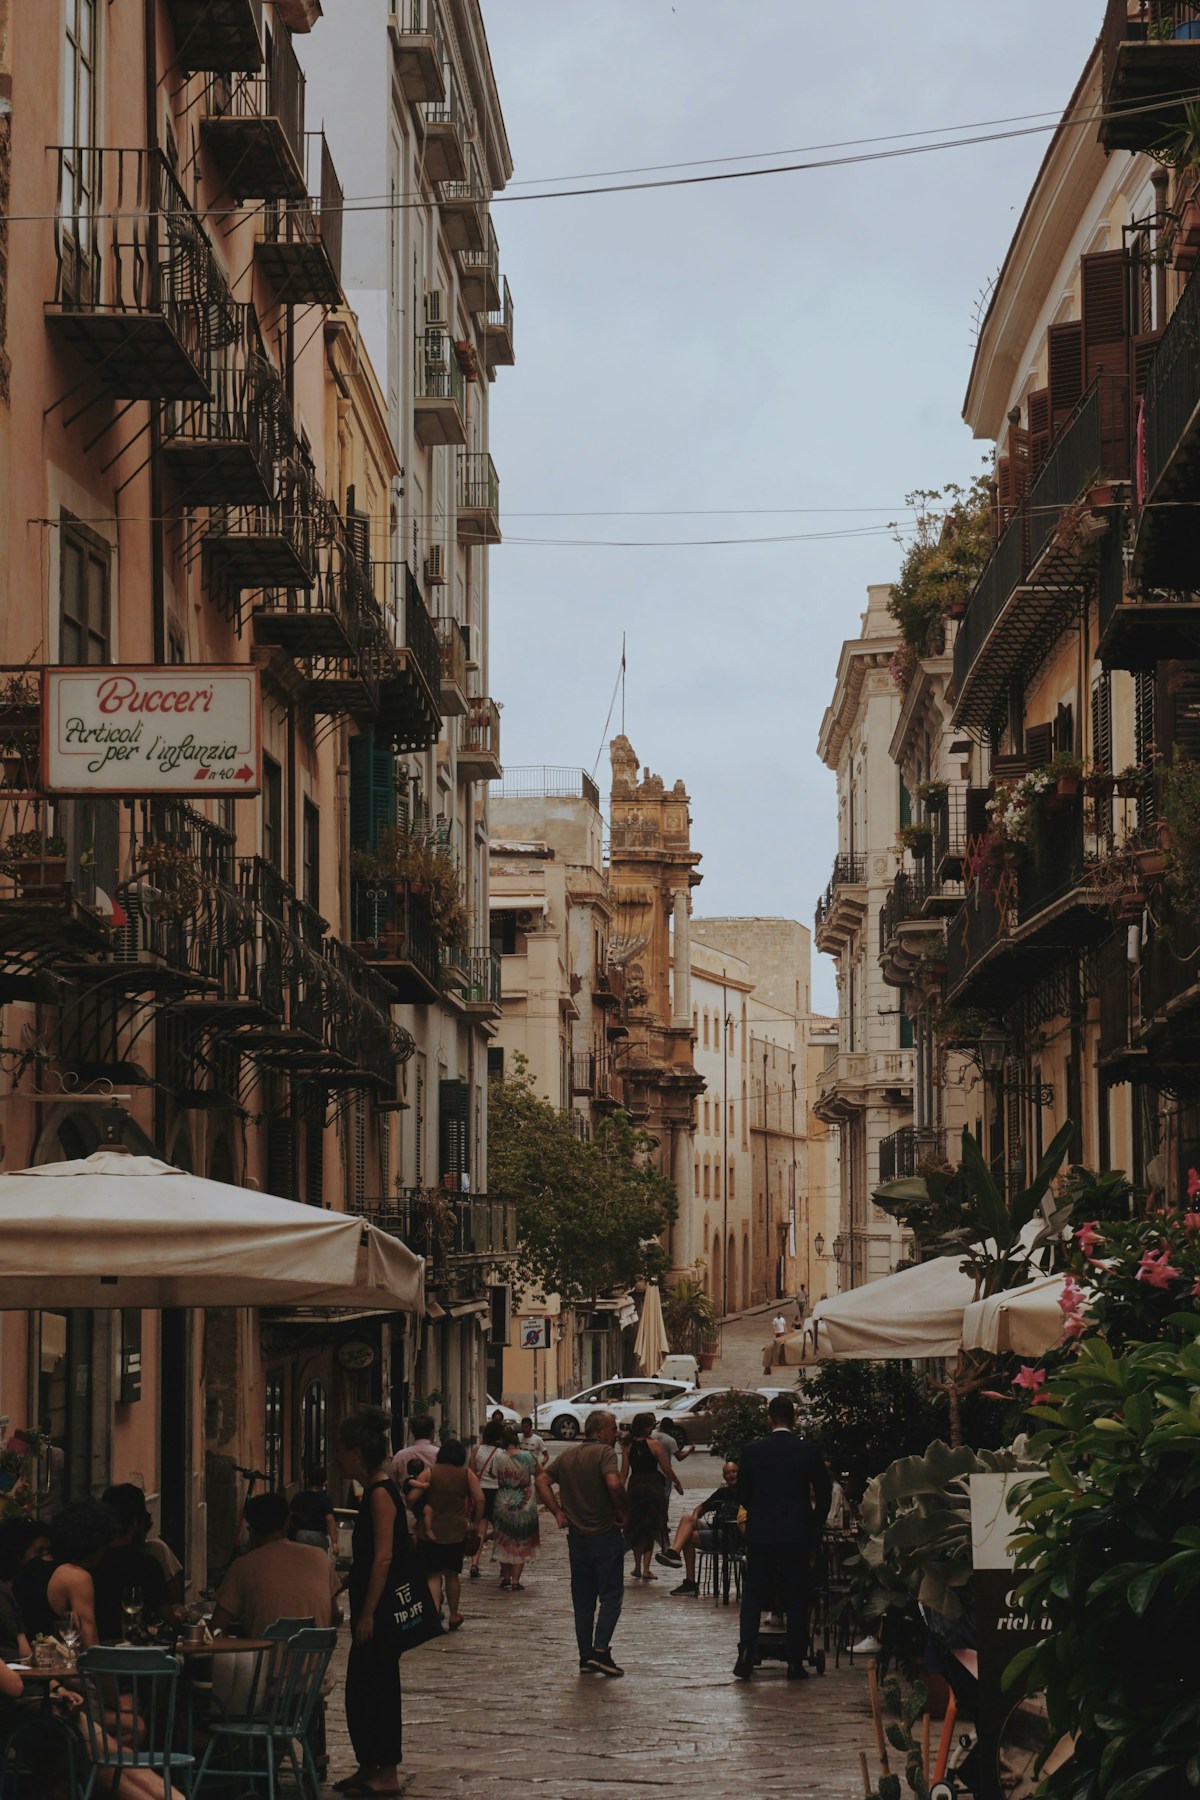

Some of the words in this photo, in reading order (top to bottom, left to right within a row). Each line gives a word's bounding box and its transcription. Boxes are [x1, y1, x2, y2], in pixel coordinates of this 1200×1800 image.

[97, 676, 213, 714] Bucceri
[65, 717, 143, 743] Articoli
[87, 745, 139, 773] per
[147, 734, 238, 773] l'infanzia
[393, 1610, 409, 1624] TIP
